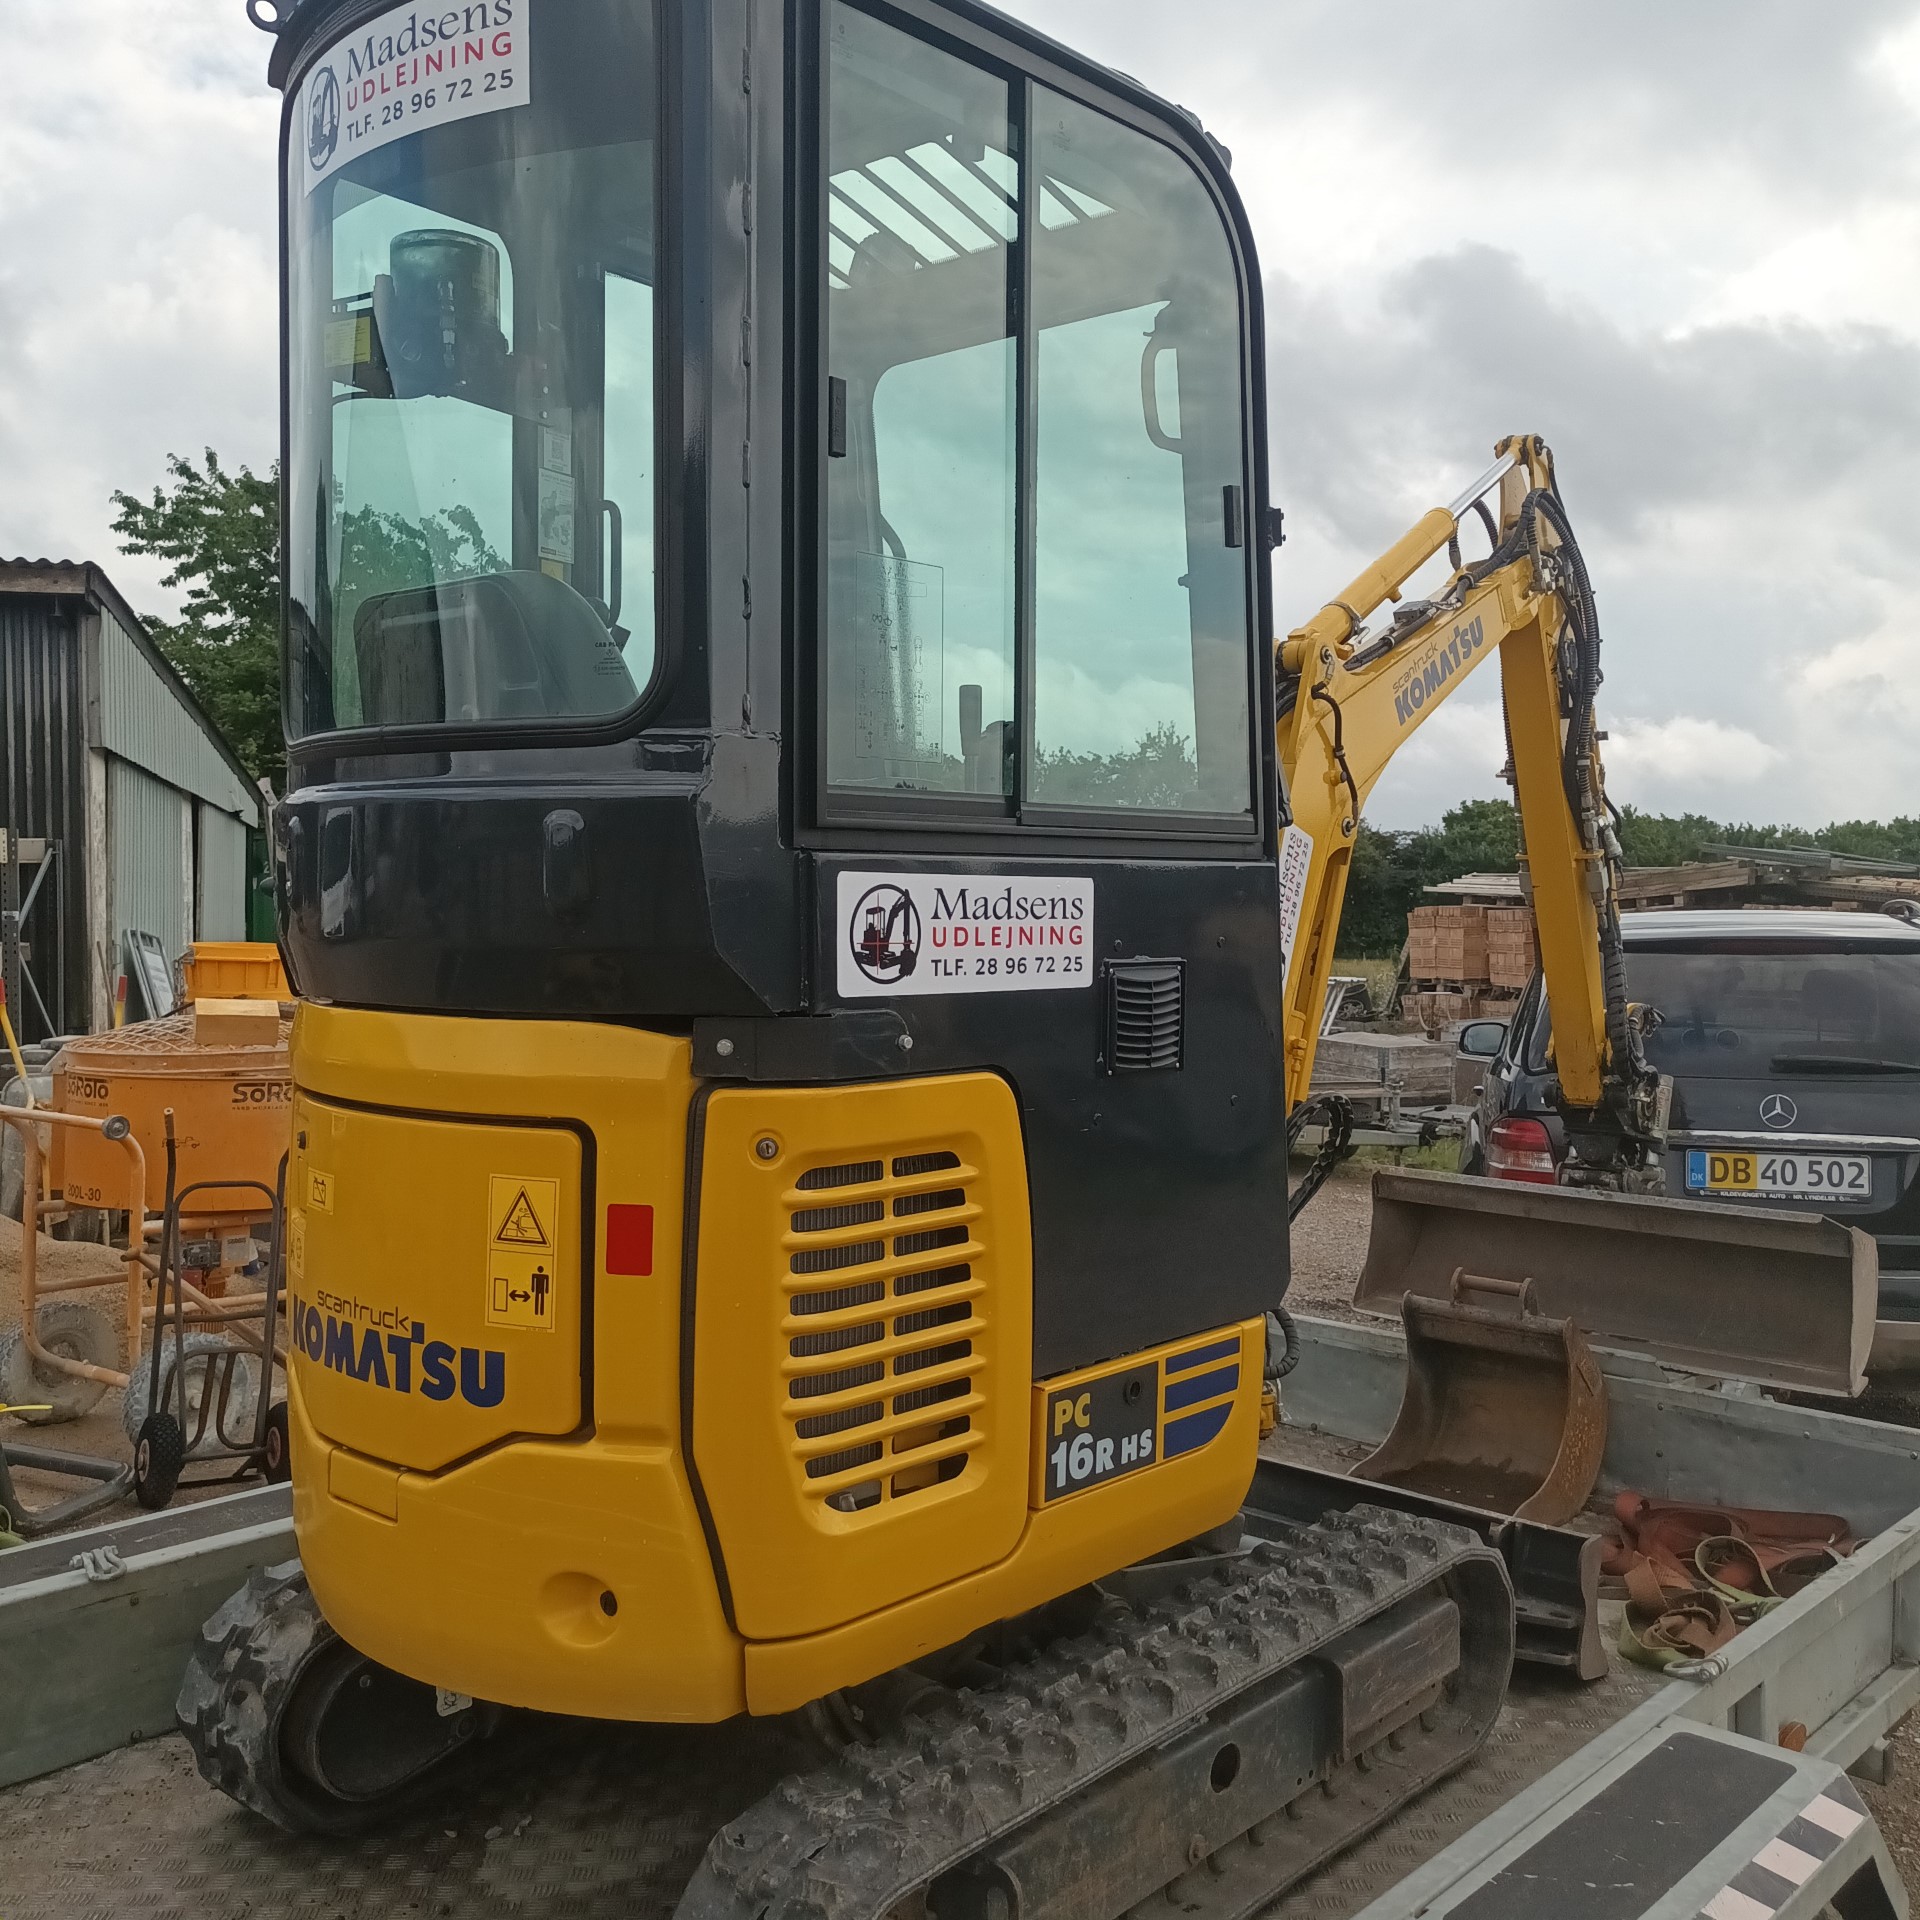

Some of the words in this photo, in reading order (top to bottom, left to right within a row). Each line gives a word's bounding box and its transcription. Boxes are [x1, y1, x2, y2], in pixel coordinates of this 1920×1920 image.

[346, 0, 513, 84] Madsens
[347, 32, 512, 111] UDLEJNING
[346, 113, 375, 142] TLF.
[381, 100, 404, 126] 28
[411, 88, 436, 114] 96
[446, 78, 473, 103] 72
[484, 68, 514, 93] 25
[1392, 642, 1438, 694] scantruck
[1394, 615, 1484, 726] KOMATSU
[930, 886, 1084, 921] Madsens
[932, 925, 1084, 949] UDLEJNING
[931, 959, 967, 976] TLF.
[975, 958, 998, 975] 28
[1005, 957, 1028, 974] 96
[1035, 957, 1055, 973] 72
[1063, 956, 1083, 972] 25
[68, 1183, 102, 1201] 200L-30
[1691, 1172, 1704, 1181] DK
[1710, 1156, 1751, 1184] DB
[1760, 1158, 1798, 1186] 40
[1807, 1160, 1865, 1189] 502
[317, 1289, 410, 1332] scantruck
[293, 1293, 505, 1408] KOMATSU
[1054, 1392, 1091, 1437] PC
[1051, 1432, 1115, 1488] 16R
[1121, 1428, 1153, 1465] HS
